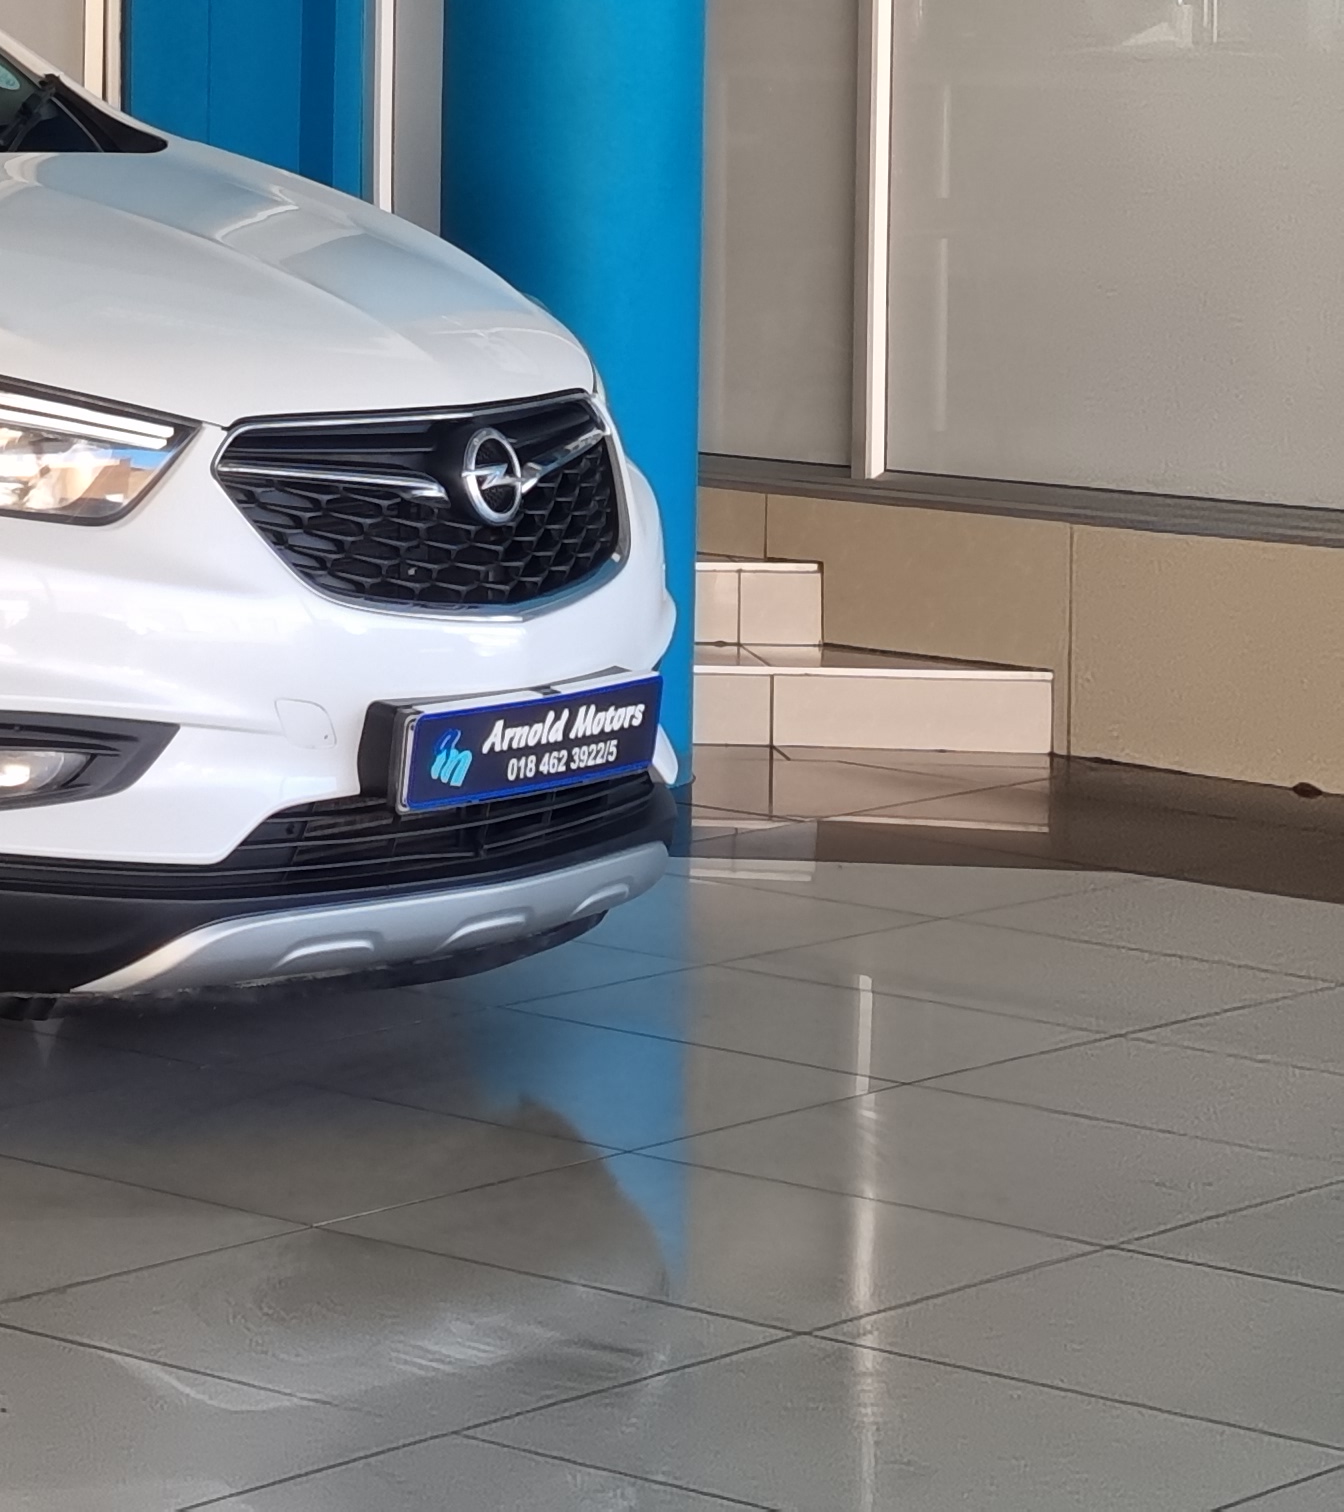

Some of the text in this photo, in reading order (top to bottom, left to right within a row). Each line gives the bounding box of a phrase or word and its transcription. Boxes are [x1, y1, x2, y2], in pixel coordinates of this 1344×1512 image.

[481, 703, 646, 755] Arnold Motors
[507, 739, 618, 781] 018 462 3922/5
